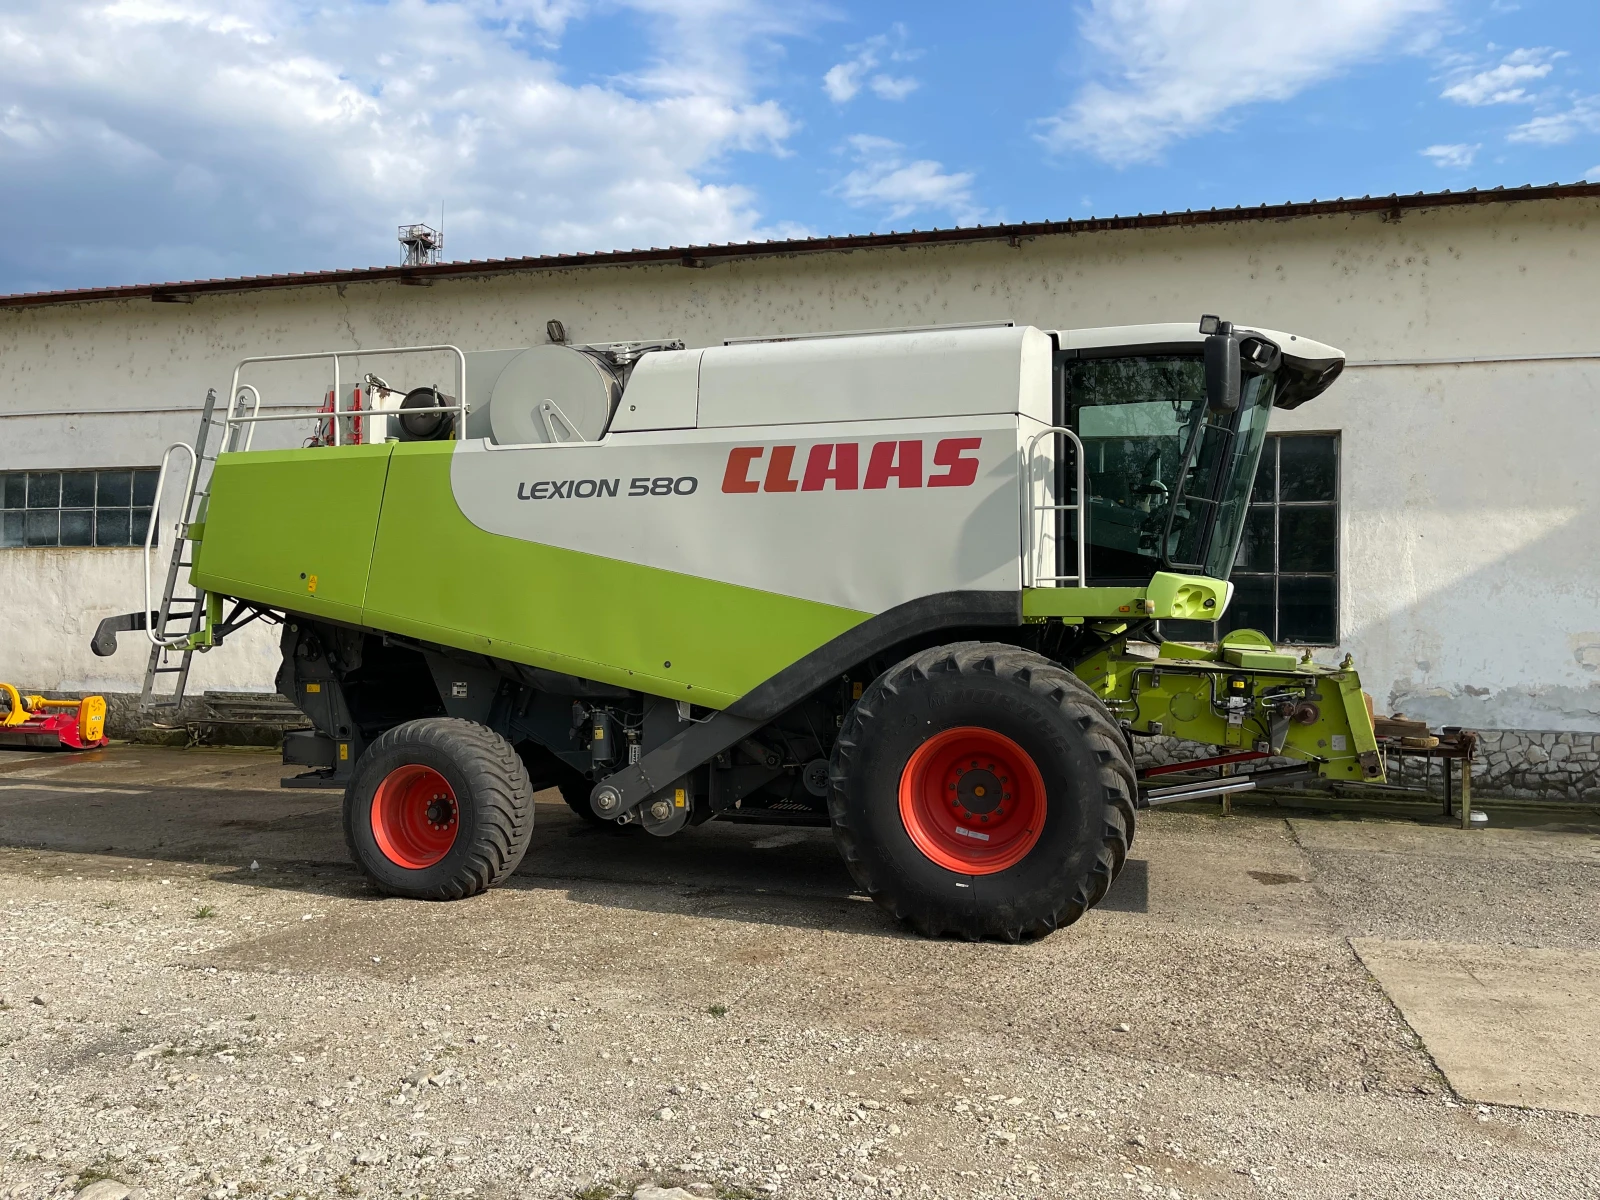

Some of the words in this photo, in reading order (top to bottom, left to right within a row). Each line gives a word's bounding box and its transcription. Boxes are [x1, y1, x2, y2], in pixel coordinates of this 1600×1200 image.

[721, 437, 982, 493] CLAAS
[517, 478, 620, 500] LEXION
[628, 476, 698, 496] 580
